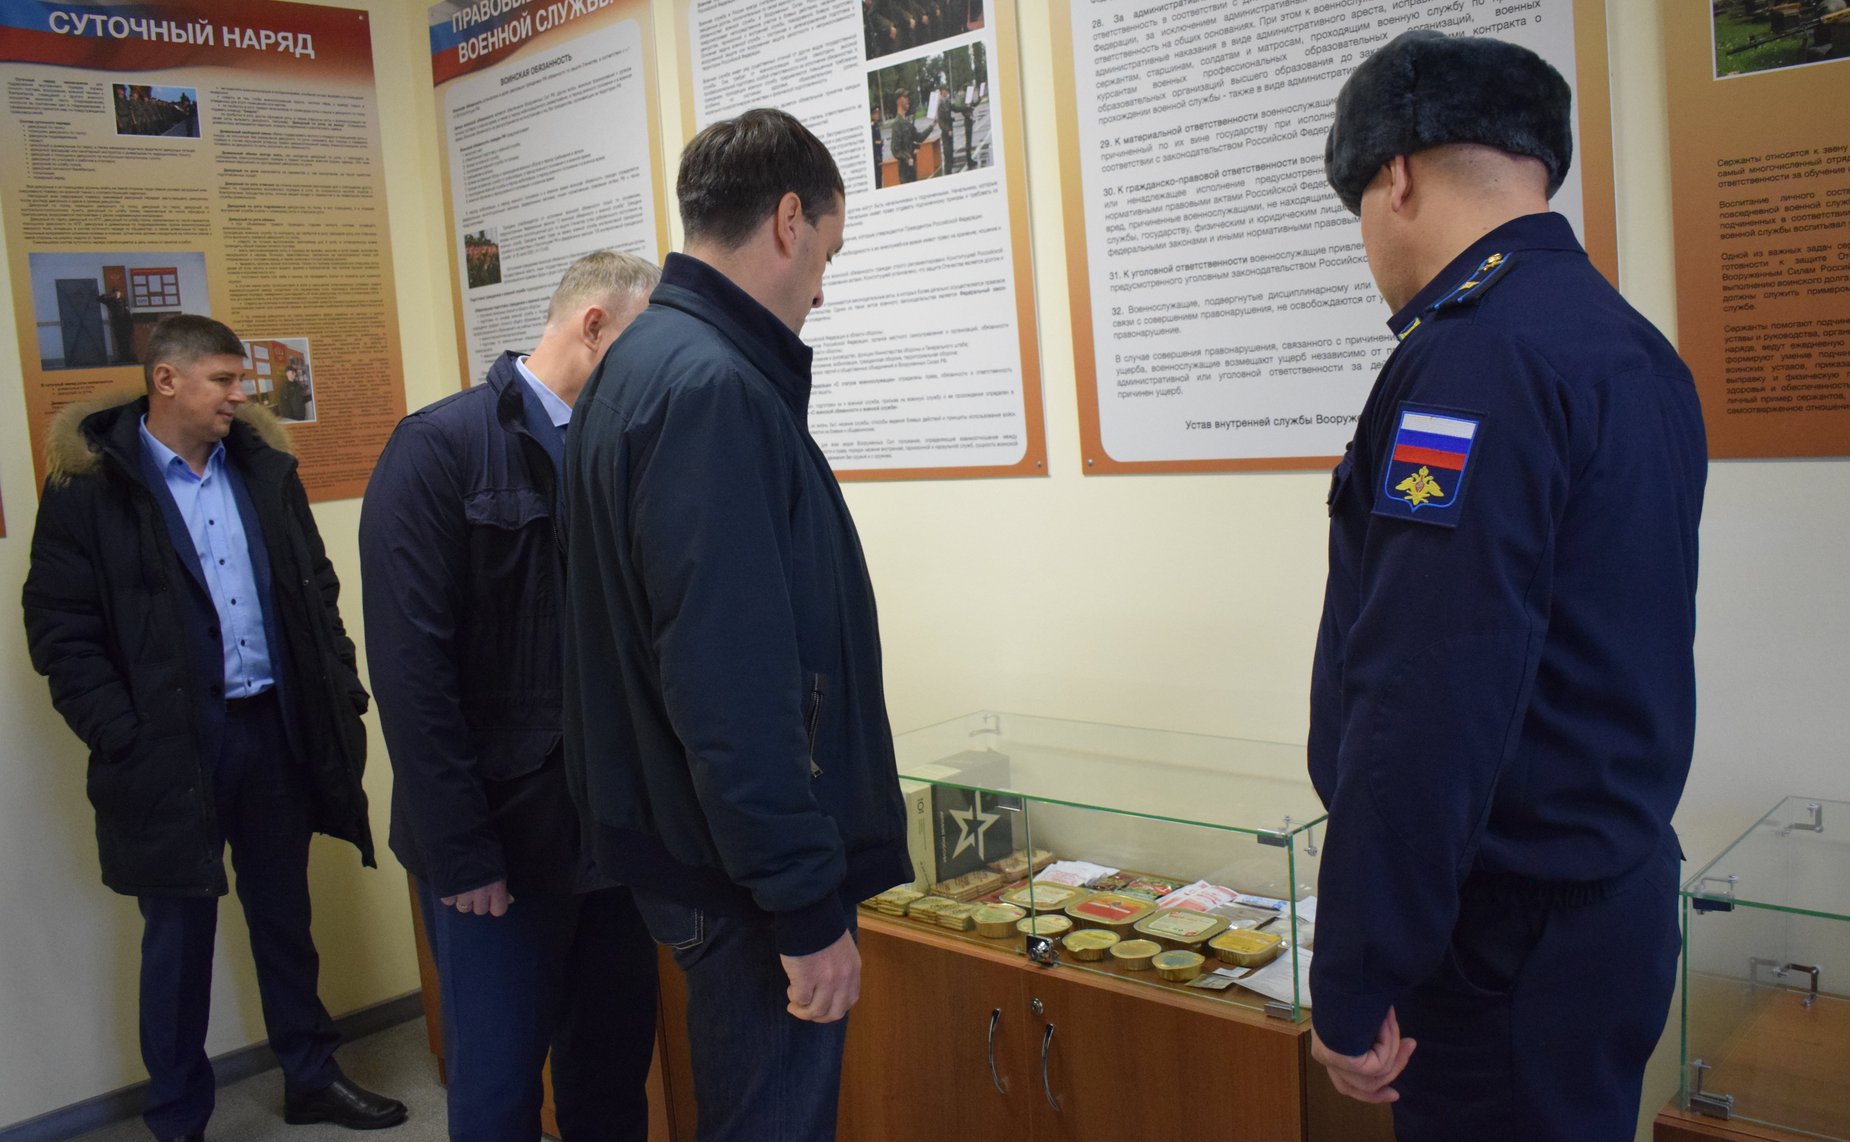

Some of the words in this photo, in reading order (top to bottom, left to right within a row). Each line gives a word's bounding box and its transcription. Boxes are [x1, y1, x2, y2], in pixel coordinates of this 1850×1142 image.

[48, 11, 214, 46] СУТОЧНЫЙ
[222, 26, 316, 59] НАРЯД
[452, 0, 533, 33] ПРАВОВЫ
[458, 11, 532, 64] ВОЕННОЙ
[1094, 44, 1159, 64] ответственность
[1173, 34, 1201, 46] общих
[1203, 22, 1256, 39] основаниях.
[1259, 16, 1277, 26] При
[1279, 10, 1302, 21] этом
[1314, 0, 1366, 14] военнослу
[1472, 18, 1526, 36] контракта
[1095, 54, 1170, 76] административные
[1173, 43, 1217, 57] наказания
[1230, 35, 1252, 45] виде
[1256, 14, 1346, 40] административного
[1350, 6, 1386, 19] ареста,
[1095, 74, 1141, 88] сержантам,
[1146, 62, 1194, 77] старшинам,
[1200, 51, 1240, 65] солдатам
[1257, 37, 1304, 52] матросам,
[1310, 22, 1370, 41] проходящим
[1377, 11, 1420, 27] военную
[1426, 0, 1464, 16] службу
[1096, 86, 1137, 101] курсантам
[1152, 76, 1187, 88] военных
[1202, 54, 1287, 77] профессиональных
[1304, 32, 1388, 55] образовательных
[1494, 0, 1540, 16] военных
[500, 68, 530, 86] ВОИНСКАЯ
[531, 53, 573, 75] ОБЯЗАННОСТЬ
[1097, 93, 1166, 112] образовательных
[1171, 78, 1224, 97] организаций
[1230, 71, 1268, 85] высшего
[1274, 57, 1334, 75] образования
[1099, 139, 1112, 148] 29.
[1123, 126, 1182, 143] материальной
[1184, 113, 1258, 132] ответственности
[1103, 187, 1115, 195] 30.
[1125, 170, 1220, 192] гражданско-правовой
[1221, 158, 1298, 176] ответственности
[1109, 270, 1121, 280] 31.
[1130, 264, 1173, 279] уголовной
[1175, 257, 1248, 271] ответственности
[1249, 247, 1326, 262] военнослужащие
[1185, 420, 1212, 429] Устав
[1214, 417, 1270, 429] внутренней
[1273, 415, 1312, 427] службы
